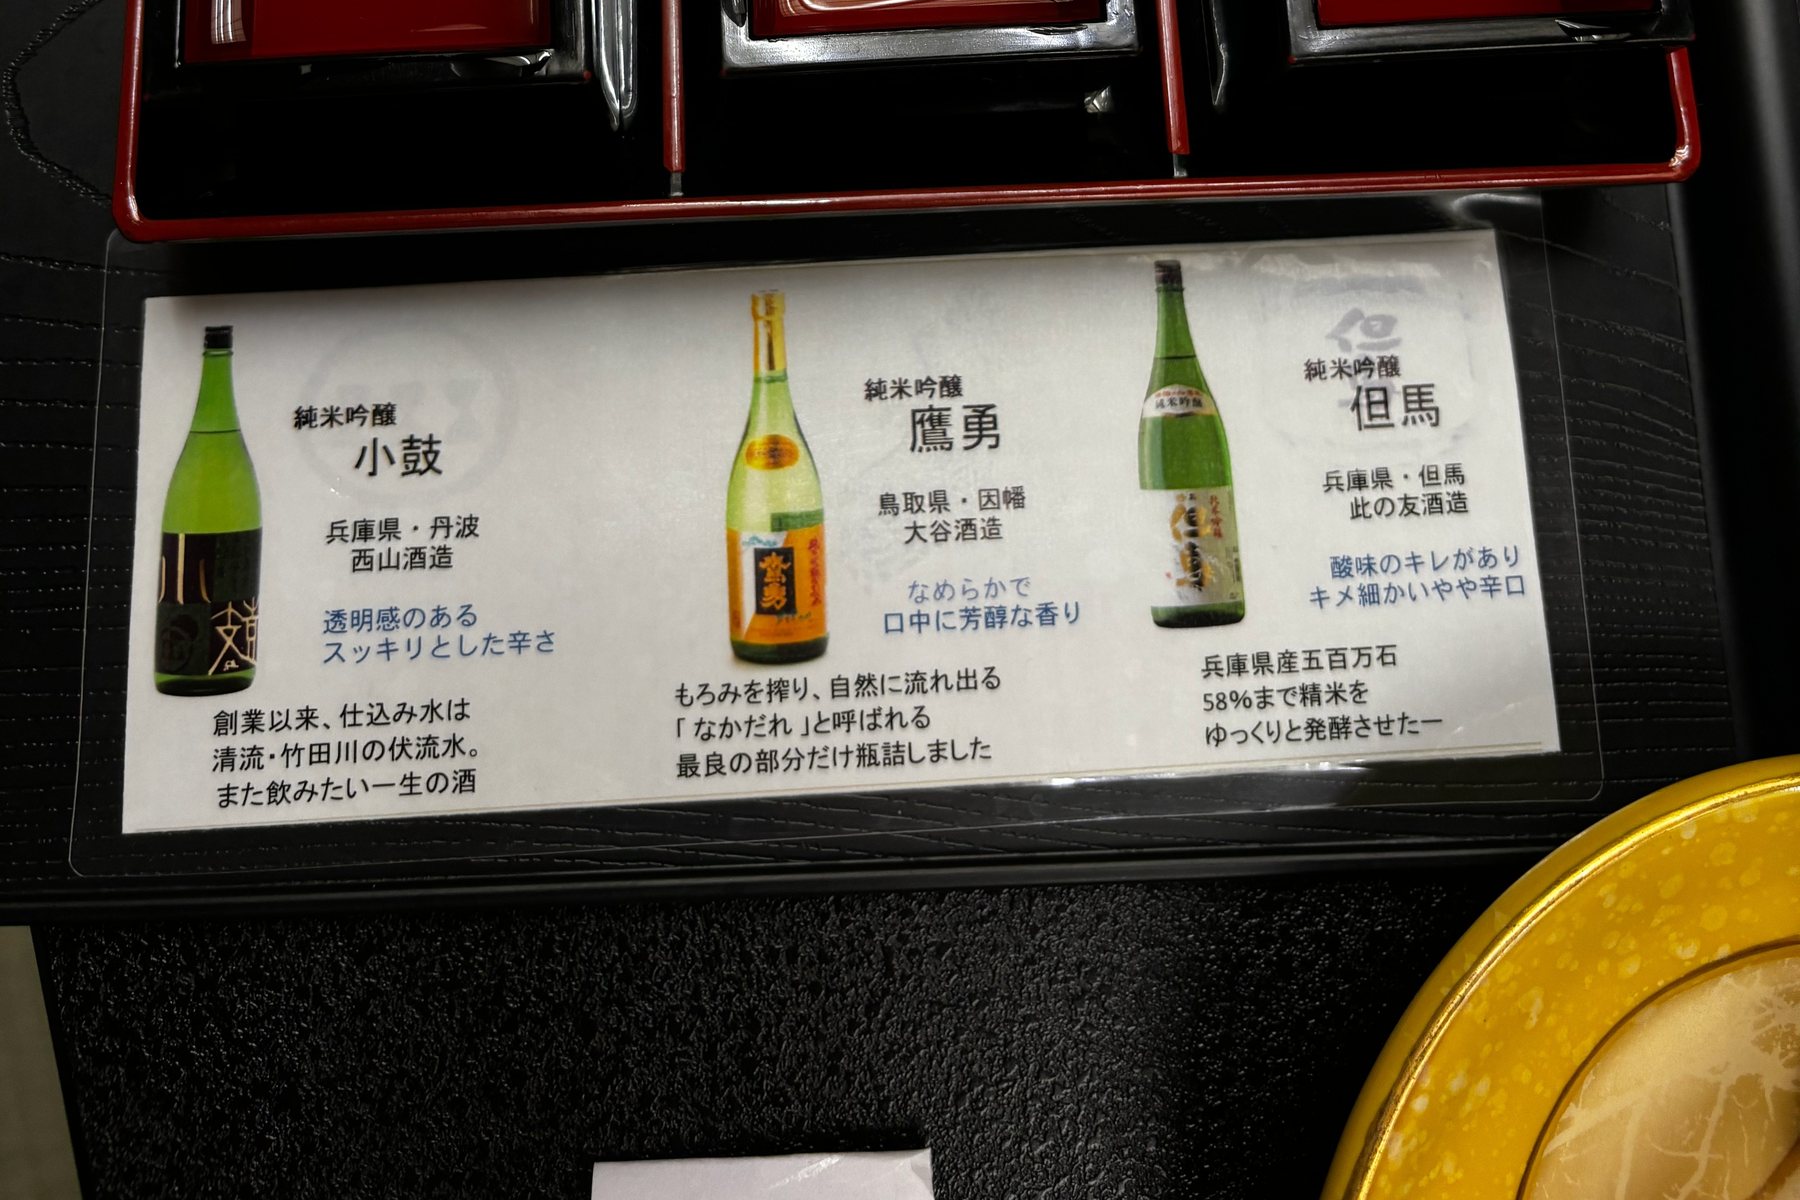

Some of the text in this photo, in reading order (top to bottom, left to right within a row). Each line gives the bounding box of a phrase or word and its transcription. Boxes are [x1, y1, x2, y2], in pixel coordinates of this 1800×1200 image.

[1303, 355, 1403, 383] 純米吟醸
[863, 374, 964, 403] 純米吟醸
[293, 402, 398, 430] 純米吟醸
[1350, 383, 1441, 432] 但馬
[909, 403, 1001, 454] 鷹勇
[353, 433, 444, 478] 小鼓
[1322, 463, 1466, 493] 兵庫県・但馬
[878, 486, 1027, 517] 鳥取県・因幡
[1349, 491, 1470, 521] 此の友酒造
[325, 514, 481, 545] 兵庫県・丹波
[903, 516, 1004, 545] 大谷酒造
[351, 545, 455, 573] 西山酒造
[1330, 545, 1519, 579] 酸味のキレがあり
[908, 576, 1031, 604] なめらかで
[1309, 574, 1526, 609] キメ細かいやや辛口
[322, 604, 478, 634] 透明感のある
[884, 601, 1081, 634] 口中に芳醇な香り
[322, 630, 556, 664] スッキリとした辛さ
[1201, 644, 1398, 678] 兵庫県産五百万石
[675, 666, 1002, 707] もろみを搾り、自然に流れ出る
[1202, 679, 1369, 712] 58%まで精米を
[213, 698, 472, 737] 創業以来、仕込み水は
[676, 705, 931, 742] 「なかだれ」と呼ばれる
[212, 733, 481, 773] 清流・竹田川の伏流水。
[675, 736, 993, 779] 最良の部分だけ瓶詰しました
[216, 768, 477, 809] また飲みたい一生の酒
